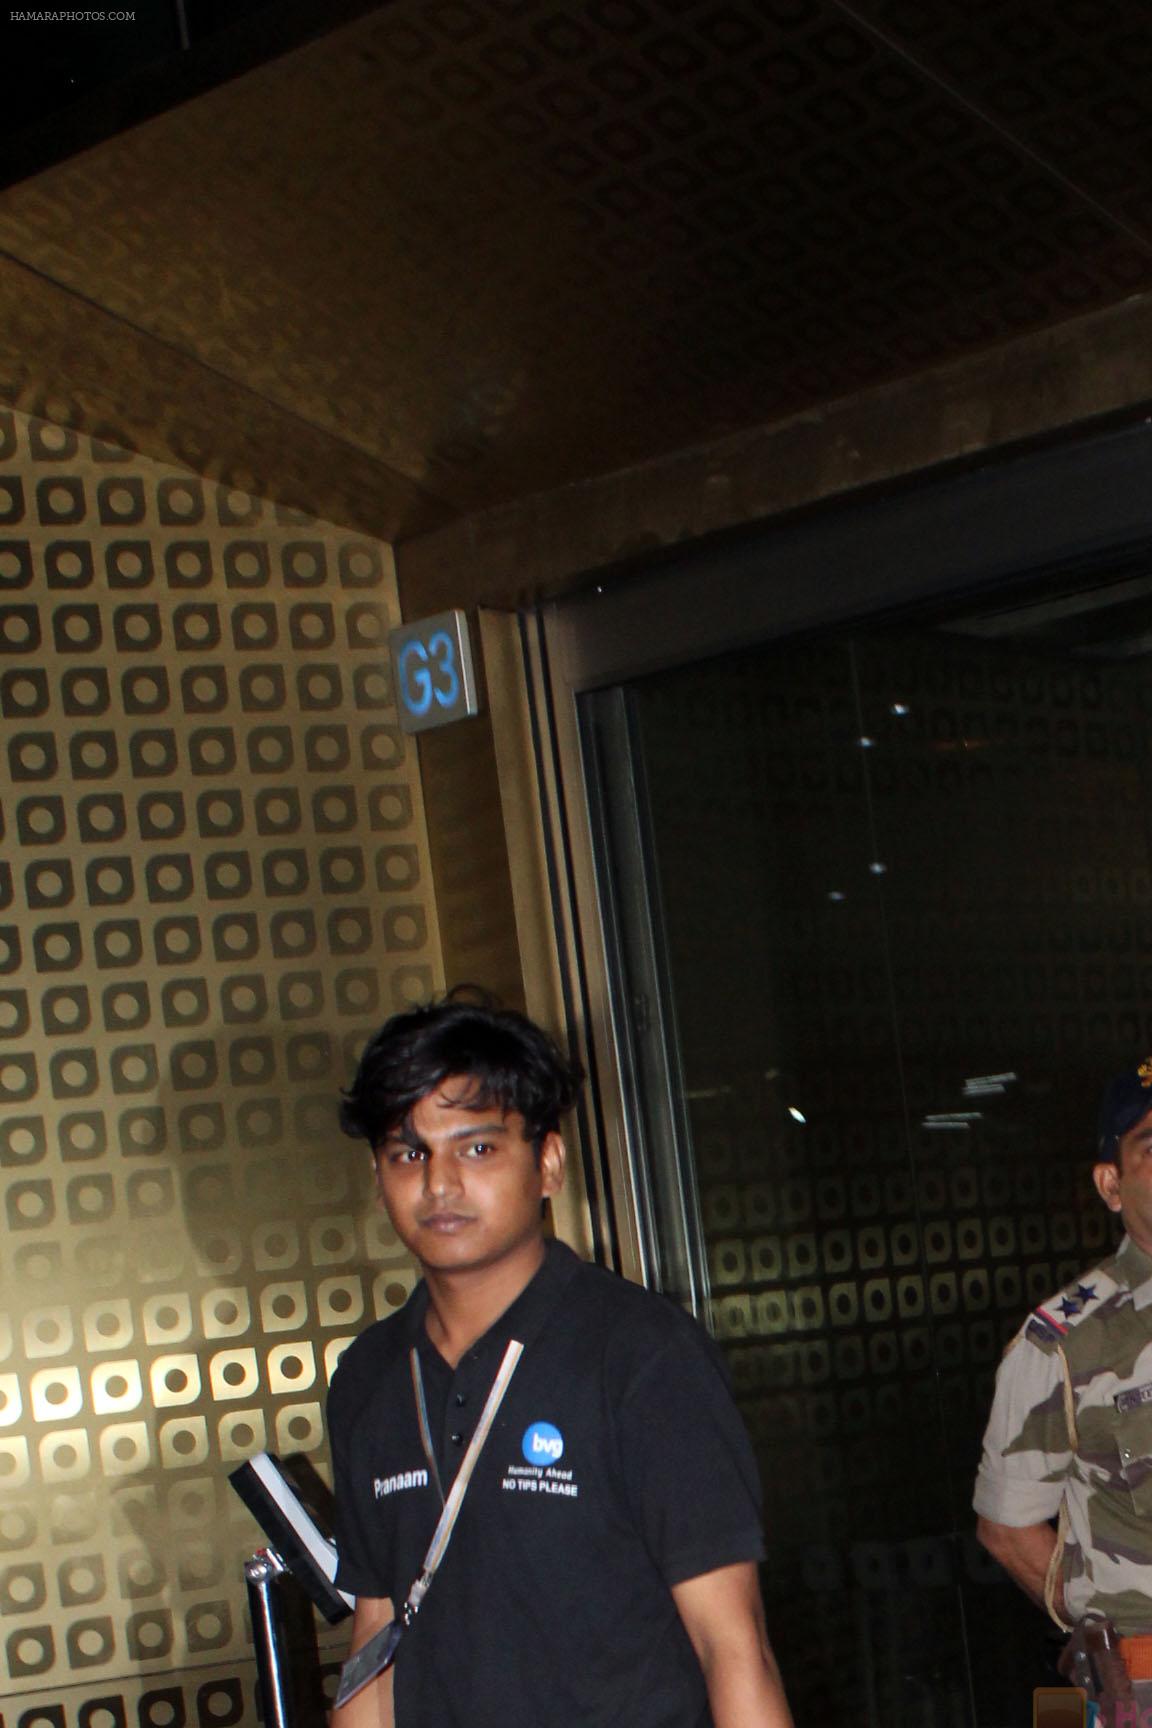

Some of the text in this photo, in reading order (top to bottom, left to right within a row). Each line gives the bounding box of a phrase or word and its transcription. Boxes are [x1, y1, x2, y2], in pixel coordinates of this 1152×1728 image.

[399, 629, 459, 717] G3
[532, 1432, 564, 1459] bvg
[374, 1469, 428, 1499] Pranaam
[502, 1478, 578, 1497] NO TIPS PLEASE
[545, 1467, 573, 1481] Ahead
